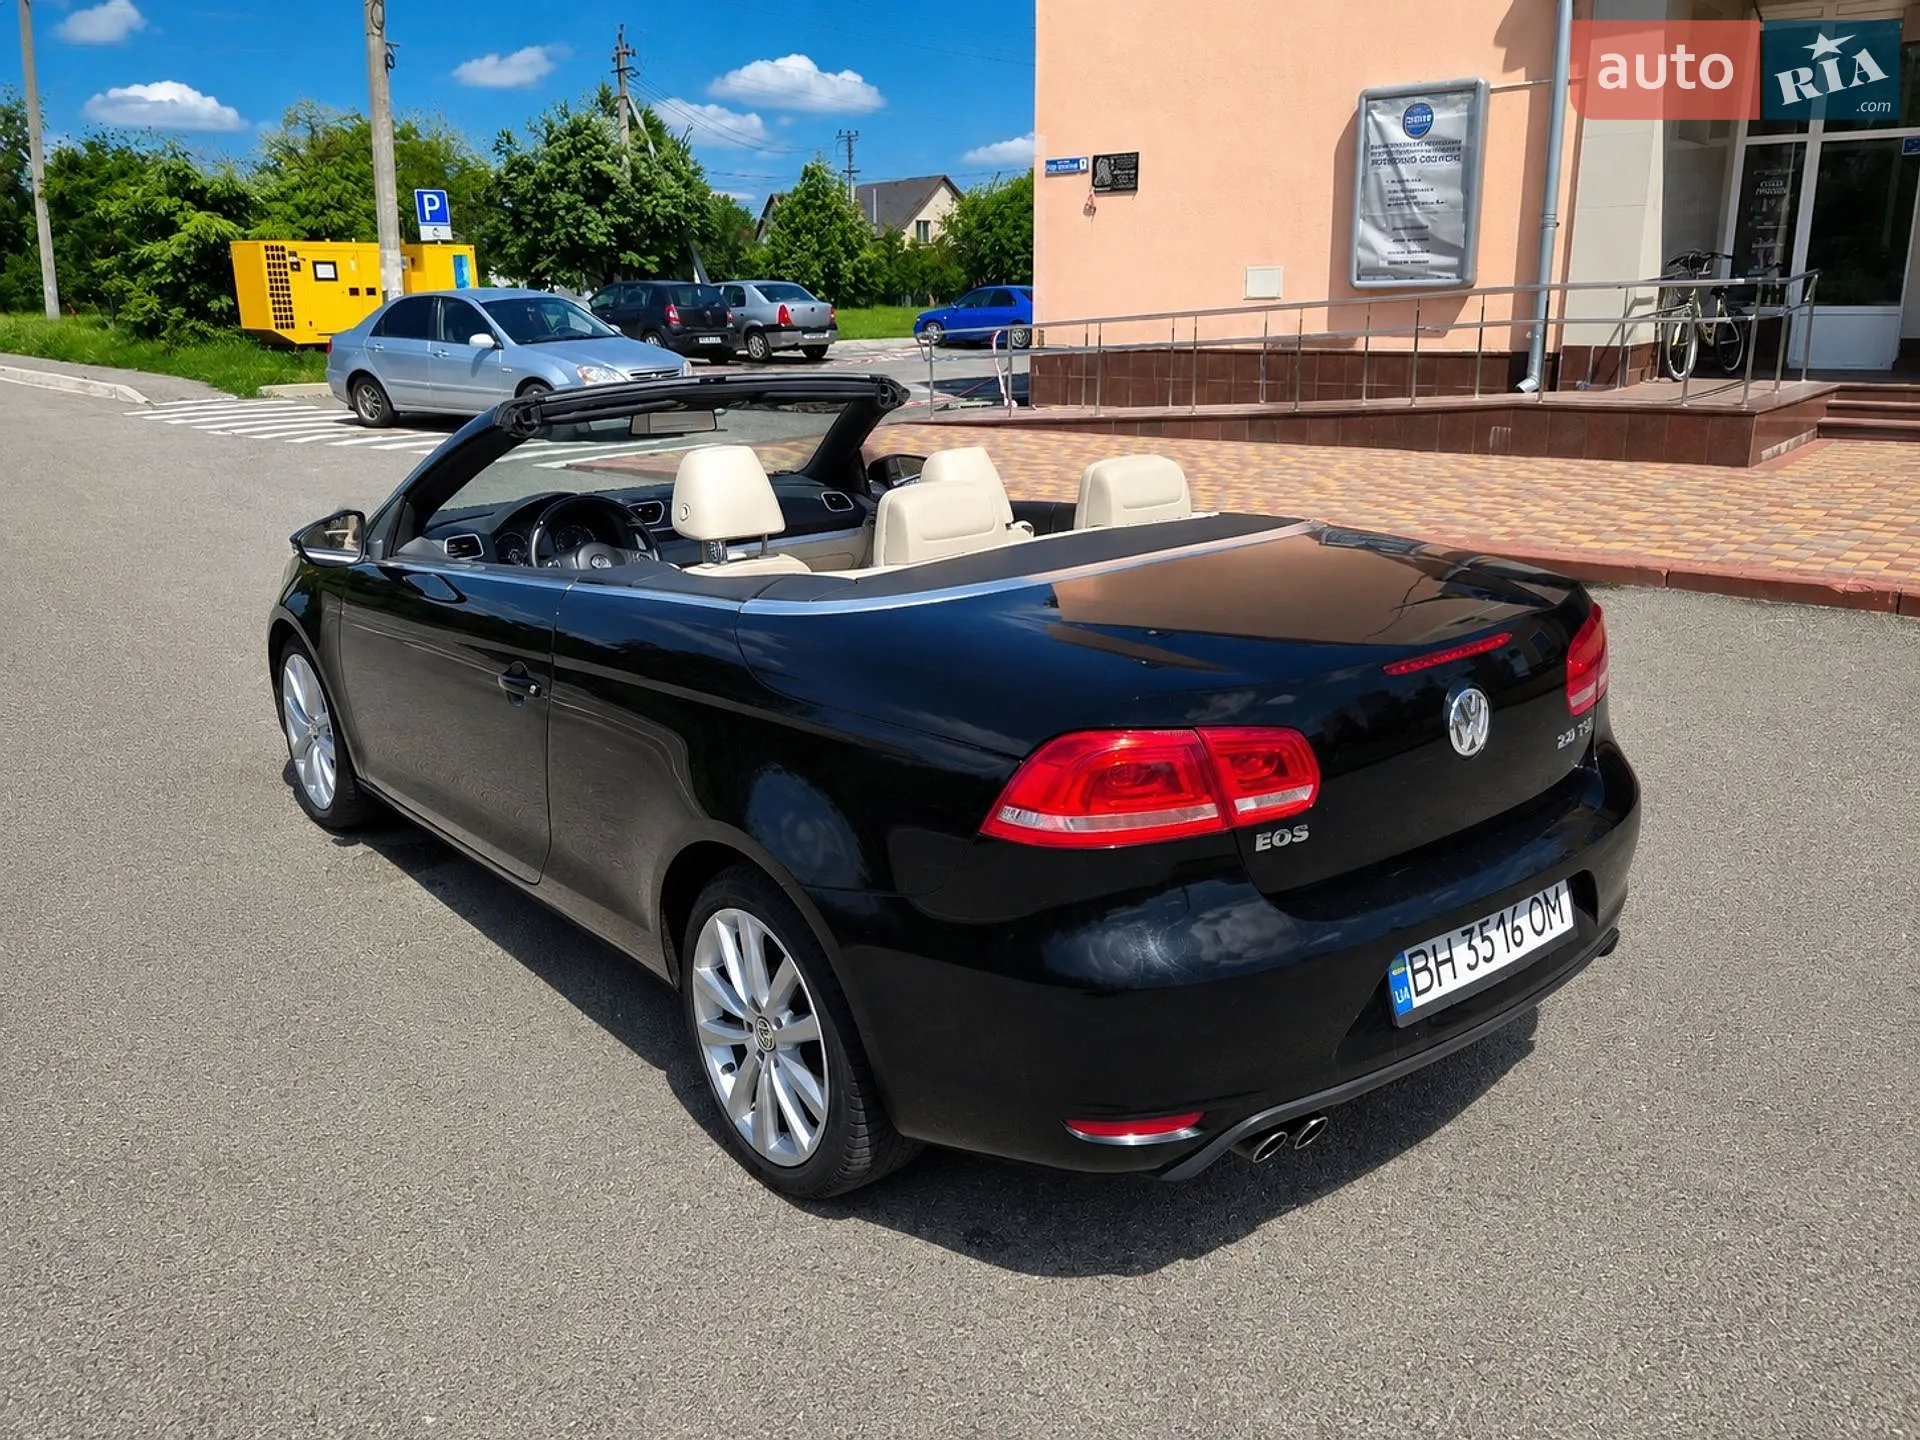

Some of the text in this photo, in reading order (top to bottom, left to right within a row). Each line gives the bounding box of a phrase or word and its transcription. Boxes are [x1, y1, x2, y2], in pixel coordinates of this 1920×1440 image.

[423, 194, 440, 221] P
[1255, 824, 1309, 852] EOS
[1408, 886, 1565, 997] BH 3516 OM
